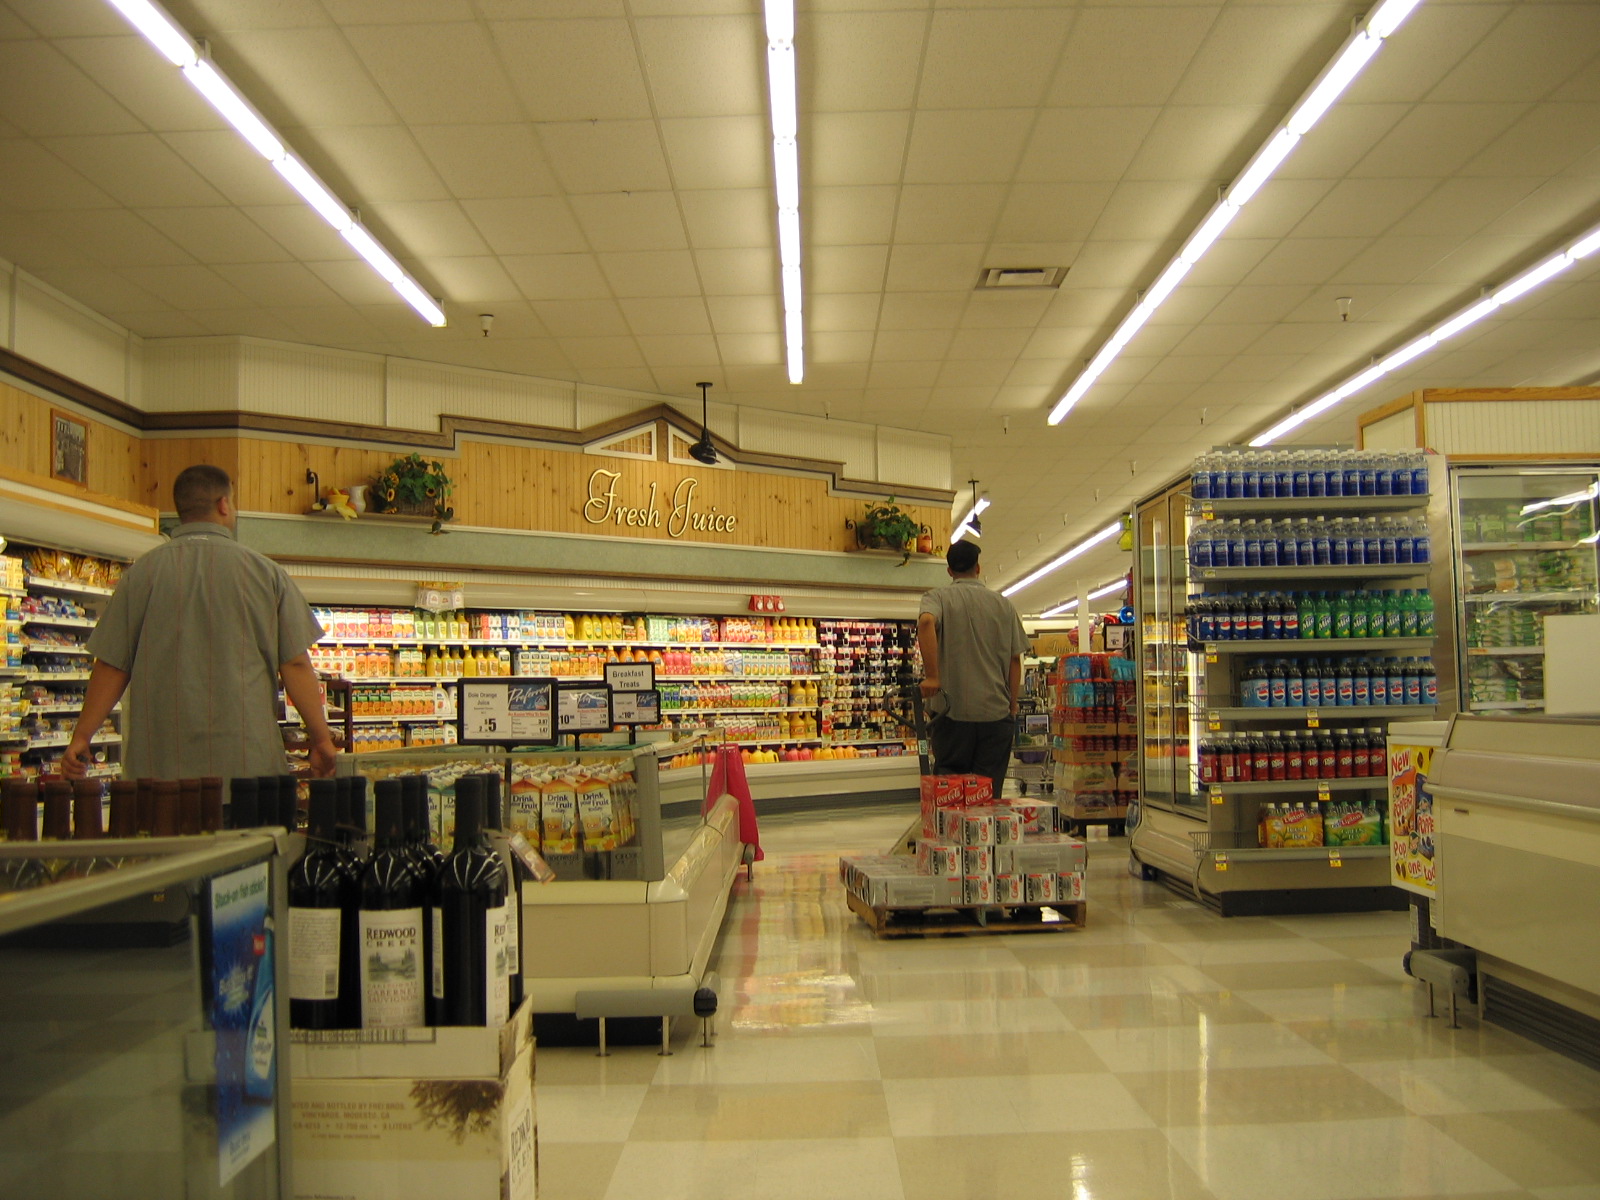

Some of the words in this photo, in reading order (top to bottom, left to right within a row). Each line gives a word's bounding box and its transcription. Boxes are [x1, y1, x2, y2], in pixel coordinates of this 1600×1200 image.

[584, 468, 661, 528] Fresh
[668, 477, 736, 538] Juice
[612, 670, 644, 678] Breakfast
[620, 681, 640, 689] Treats
[1392, 750, 1410, 777] New
[512, 794, 534, 802] Drink
[547, 793, 568, 802] Drink
[582, 792, 604, 801] Drink
[521, 802, 538, 810] Fruit
[556, 801, 573, 809] Fruit
[592, 798, 609, 807] Fruit
[1284, 812, 1305, 824] Lipton
[1341, 814, 1362, 826] Lipton
[1418, 813, 1434, 835] POPPE
[1394, 840, 1407, 860] Pop
[1408, 859, 1422, 875] one
[366, 927, 416, 940] REDWOOD
[366, 938, 416, 947] CREEK
